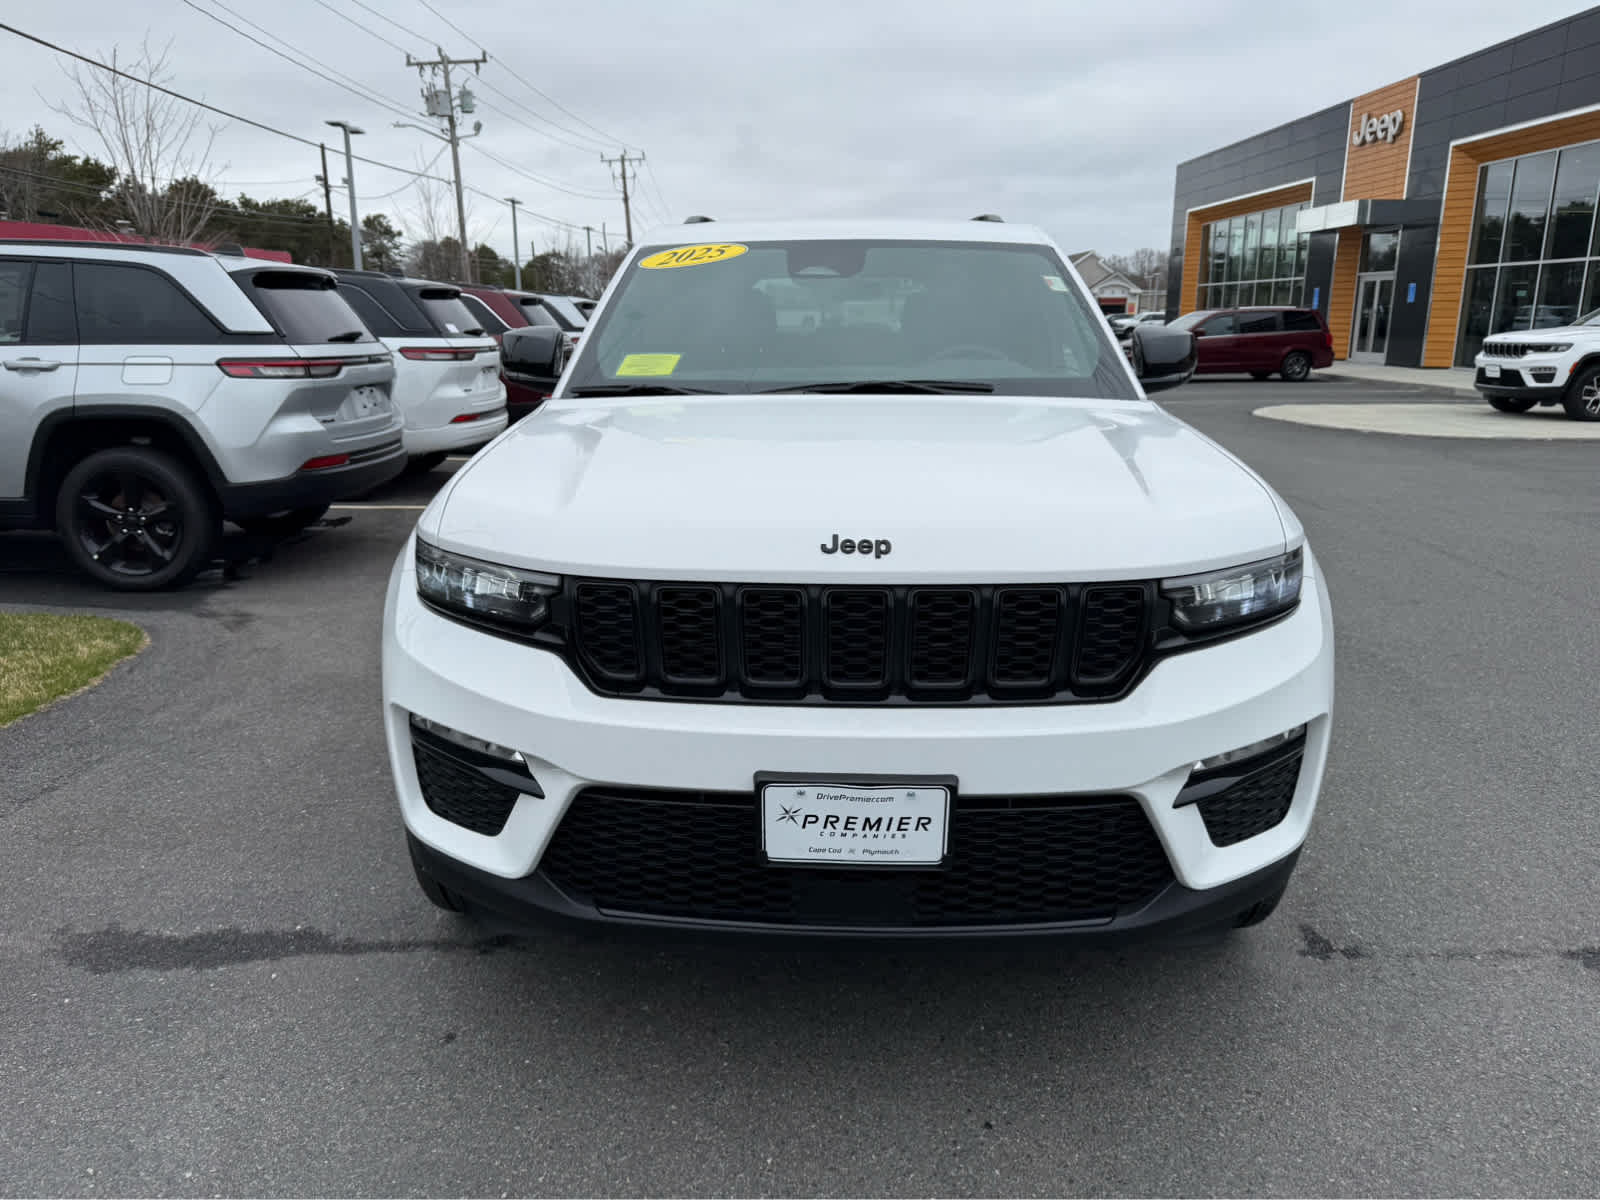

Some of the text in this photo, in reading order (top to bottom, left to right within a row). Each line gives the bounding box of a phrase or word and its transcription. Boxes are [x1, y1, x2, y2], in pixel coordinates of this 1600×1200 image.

[1352, 109, 1404, 146] Jeep
[656, 244, 732, 266] 2025
[820, 533, 892, 560] Jeep
[801, 814, 932, 832] PREMIER
[819, 831, 907, 839] COMPANIES
[808, 846, 843, 855] Cape Cod
[862, 847, 900, 856] Plymouth
